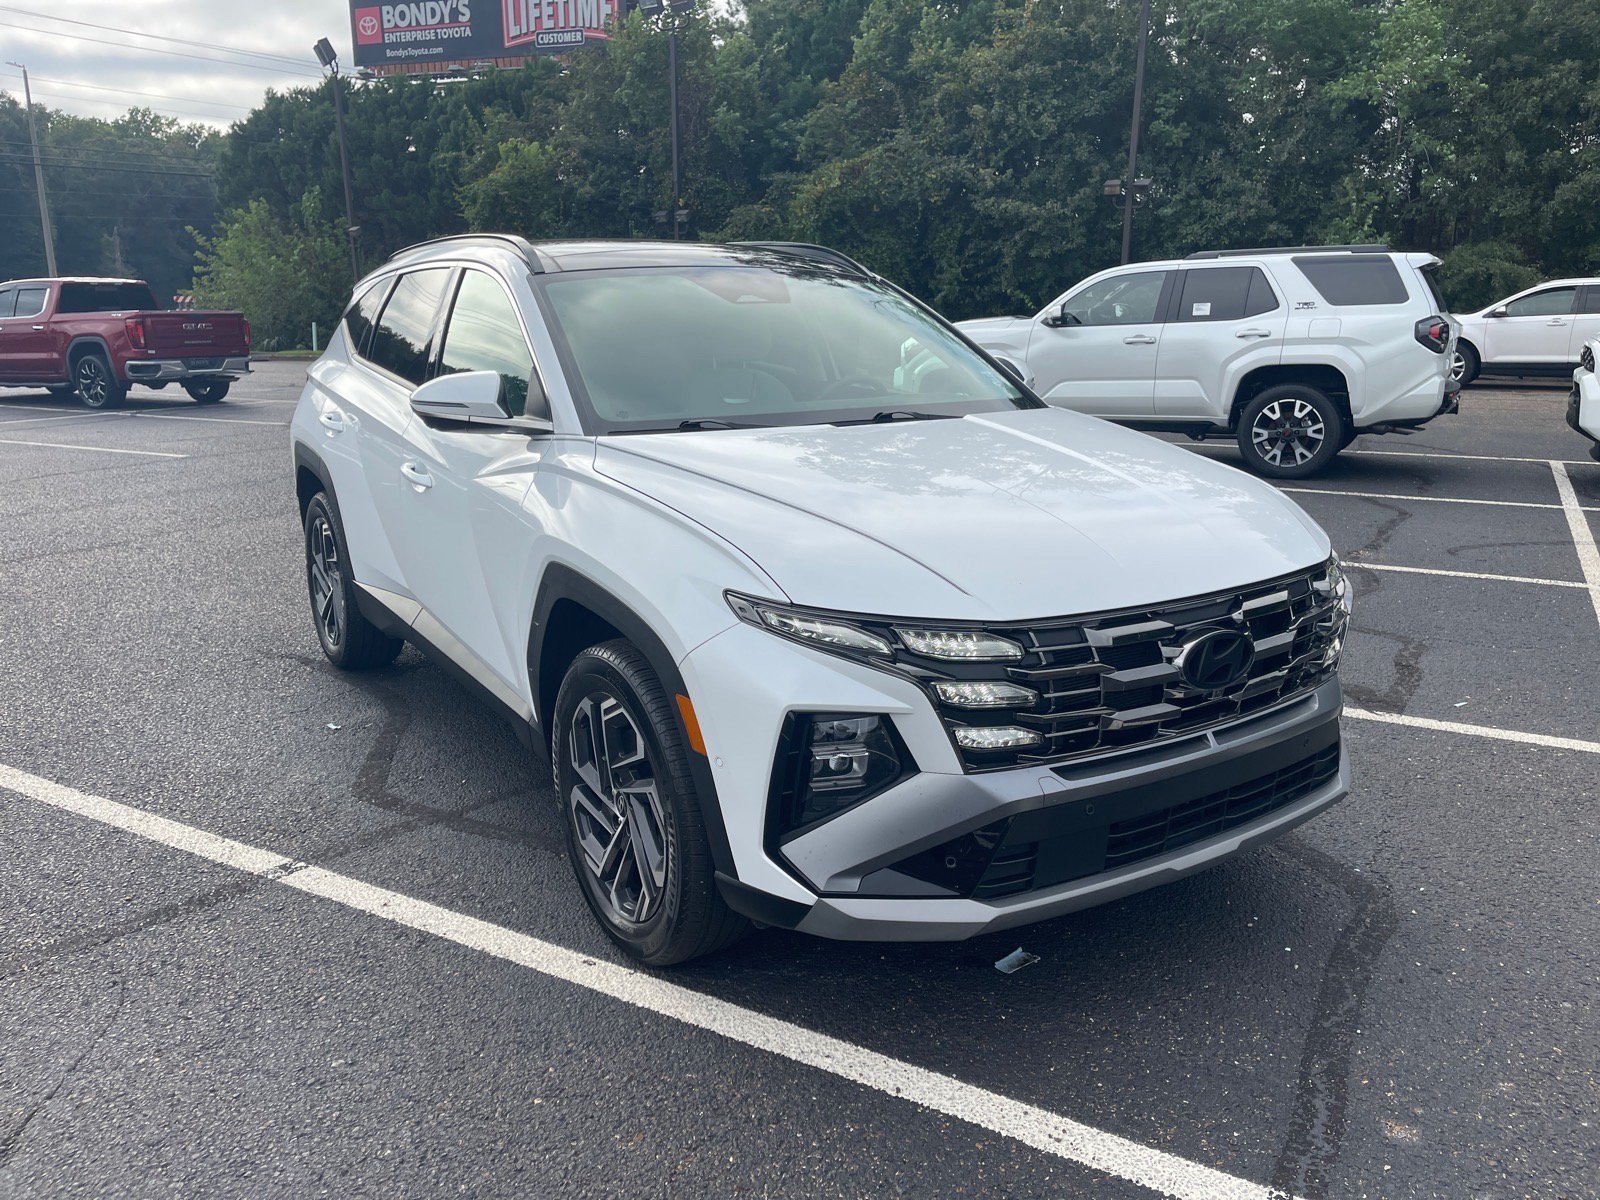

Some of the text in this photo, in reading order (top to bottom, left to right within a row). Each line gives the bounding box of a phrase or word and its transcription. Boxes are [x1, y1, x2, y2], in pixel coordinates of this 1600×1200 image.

[382, 0, 471, 29] BONDY'S
[384, 26, 472, 43] ENTERPRISE TOYOTA
[537, 31, 582, 44] CUSTOMER
[386, 46, 444, 58] BondysToyota.com
